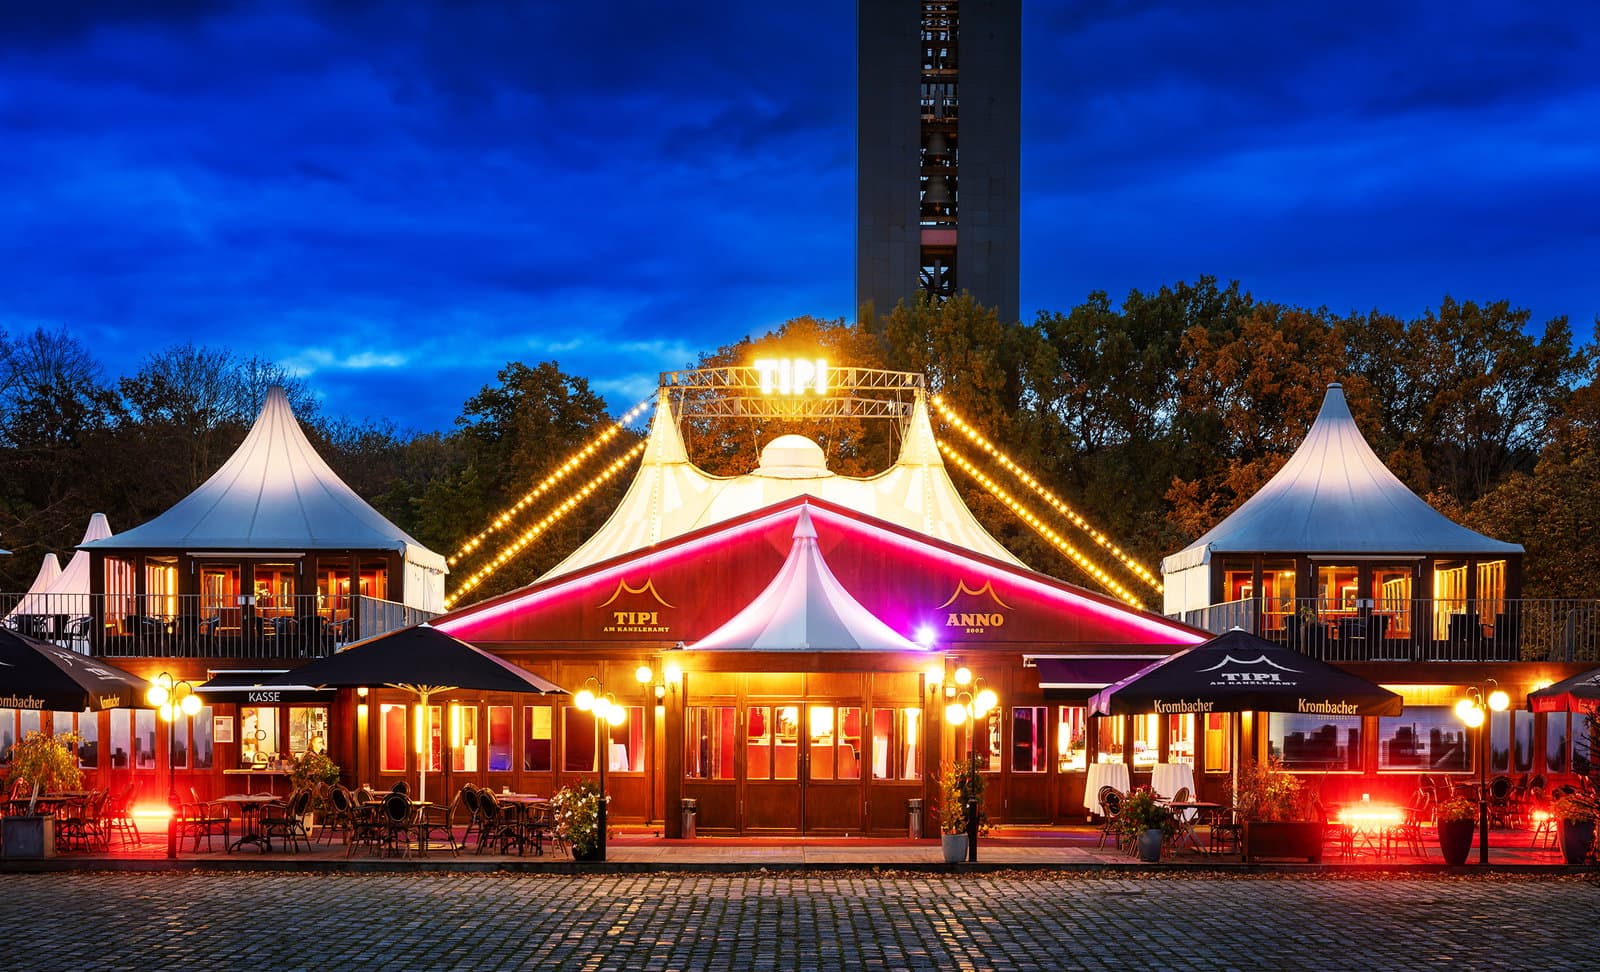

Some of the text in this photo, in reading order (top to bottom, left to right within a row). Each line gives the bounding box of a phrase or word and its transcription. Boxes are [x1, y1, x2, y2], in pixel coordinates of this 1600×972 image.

[753, 358, 827, 394] TIPI
[613, 611, 658, 625] TIPI
[945, 613, 1004, 627] ANNO
[1221, 672, 1281, 681] TIPI
[248, 691, 281, 702] KASSE
[1153, 698, 1214, 713] Krombacher
[1298, 698, 1359, 714] Krombacher
